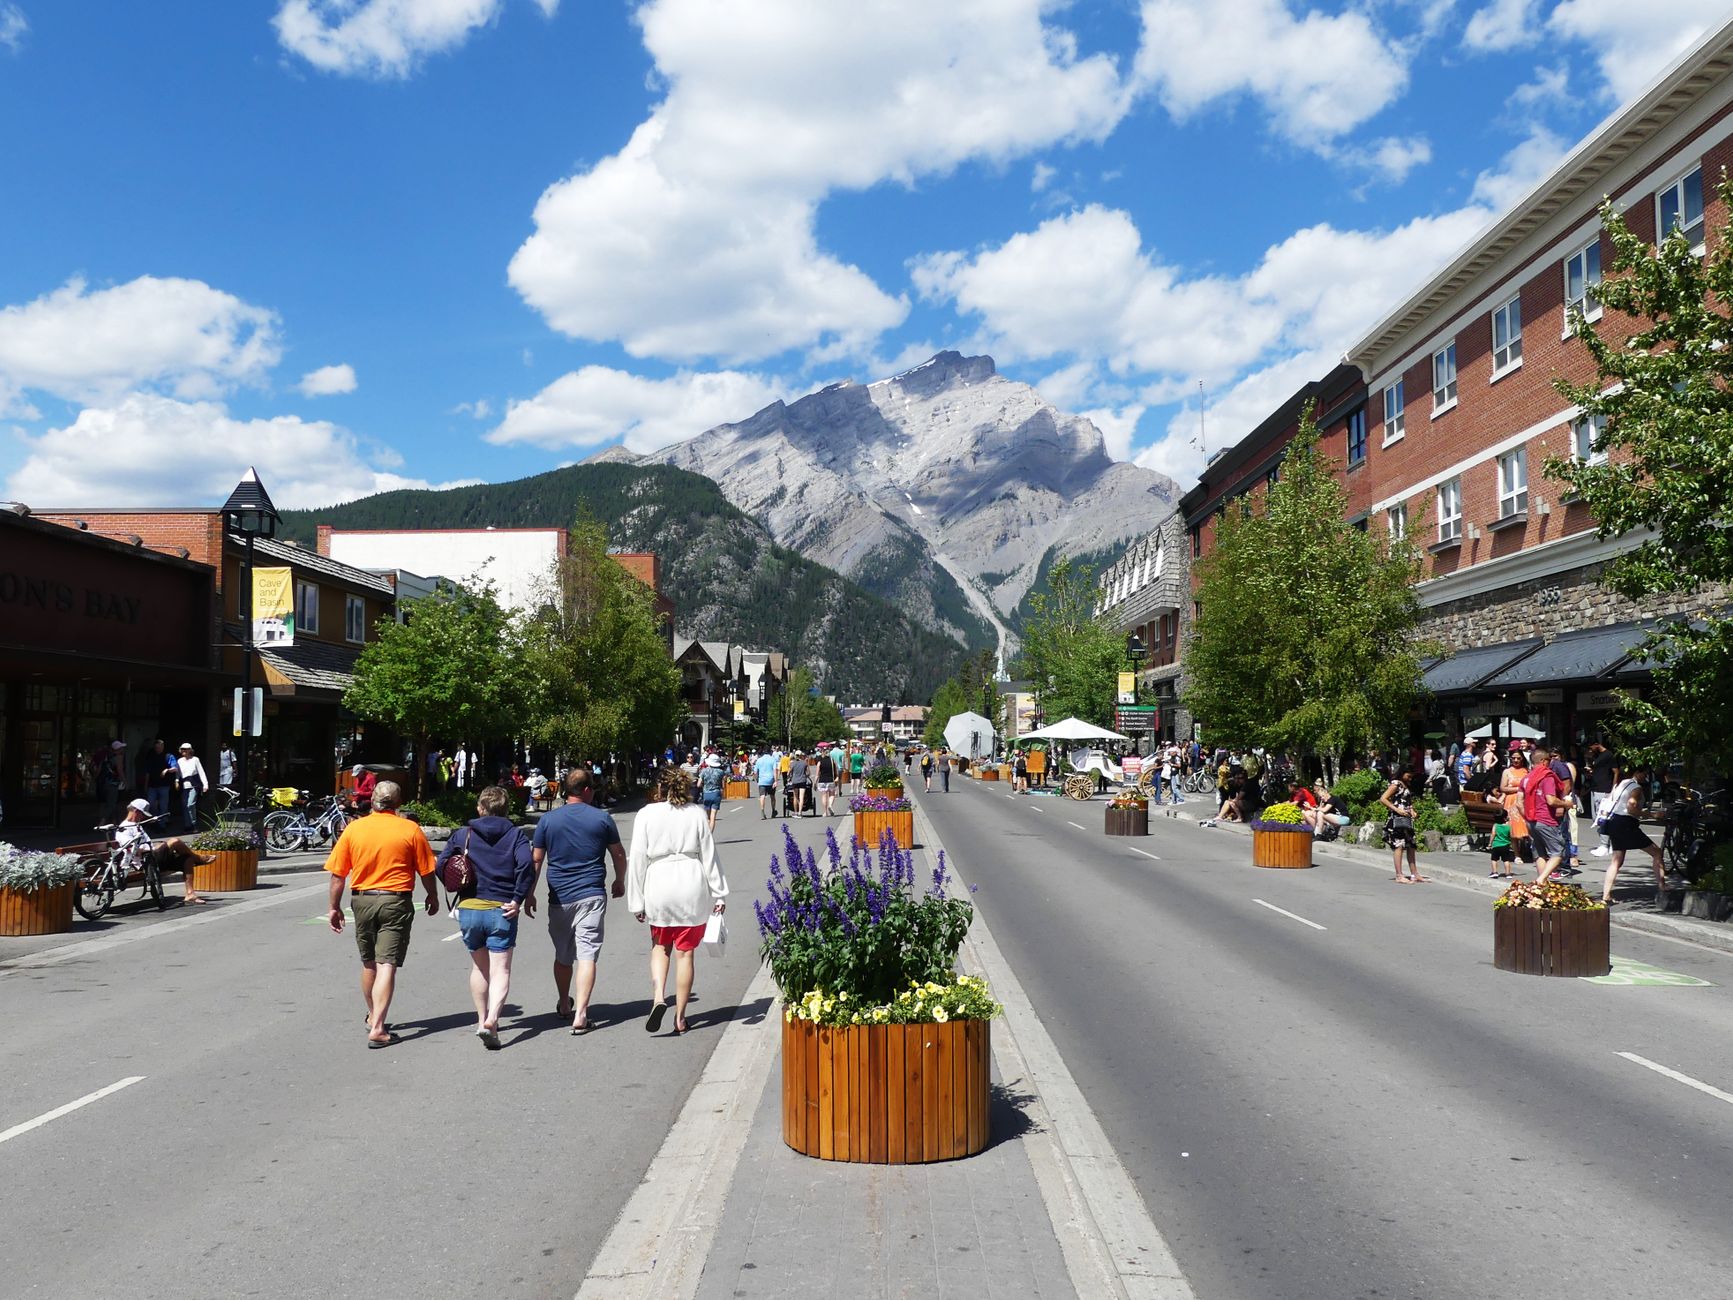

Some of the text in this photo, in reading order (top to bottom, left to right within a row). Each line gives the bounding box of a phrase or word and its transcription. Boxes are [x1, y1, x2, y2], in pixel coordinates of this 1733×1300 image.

[259, 578, 282, 588] Cave
[259, 588, 277, 597] and
[1538, 585, 1561, 604] 1955
[85, 589, 142, 624] BAY
[259, 598, 285, 607] Basin
[1591, 694, 1621, 705] Smartwo
